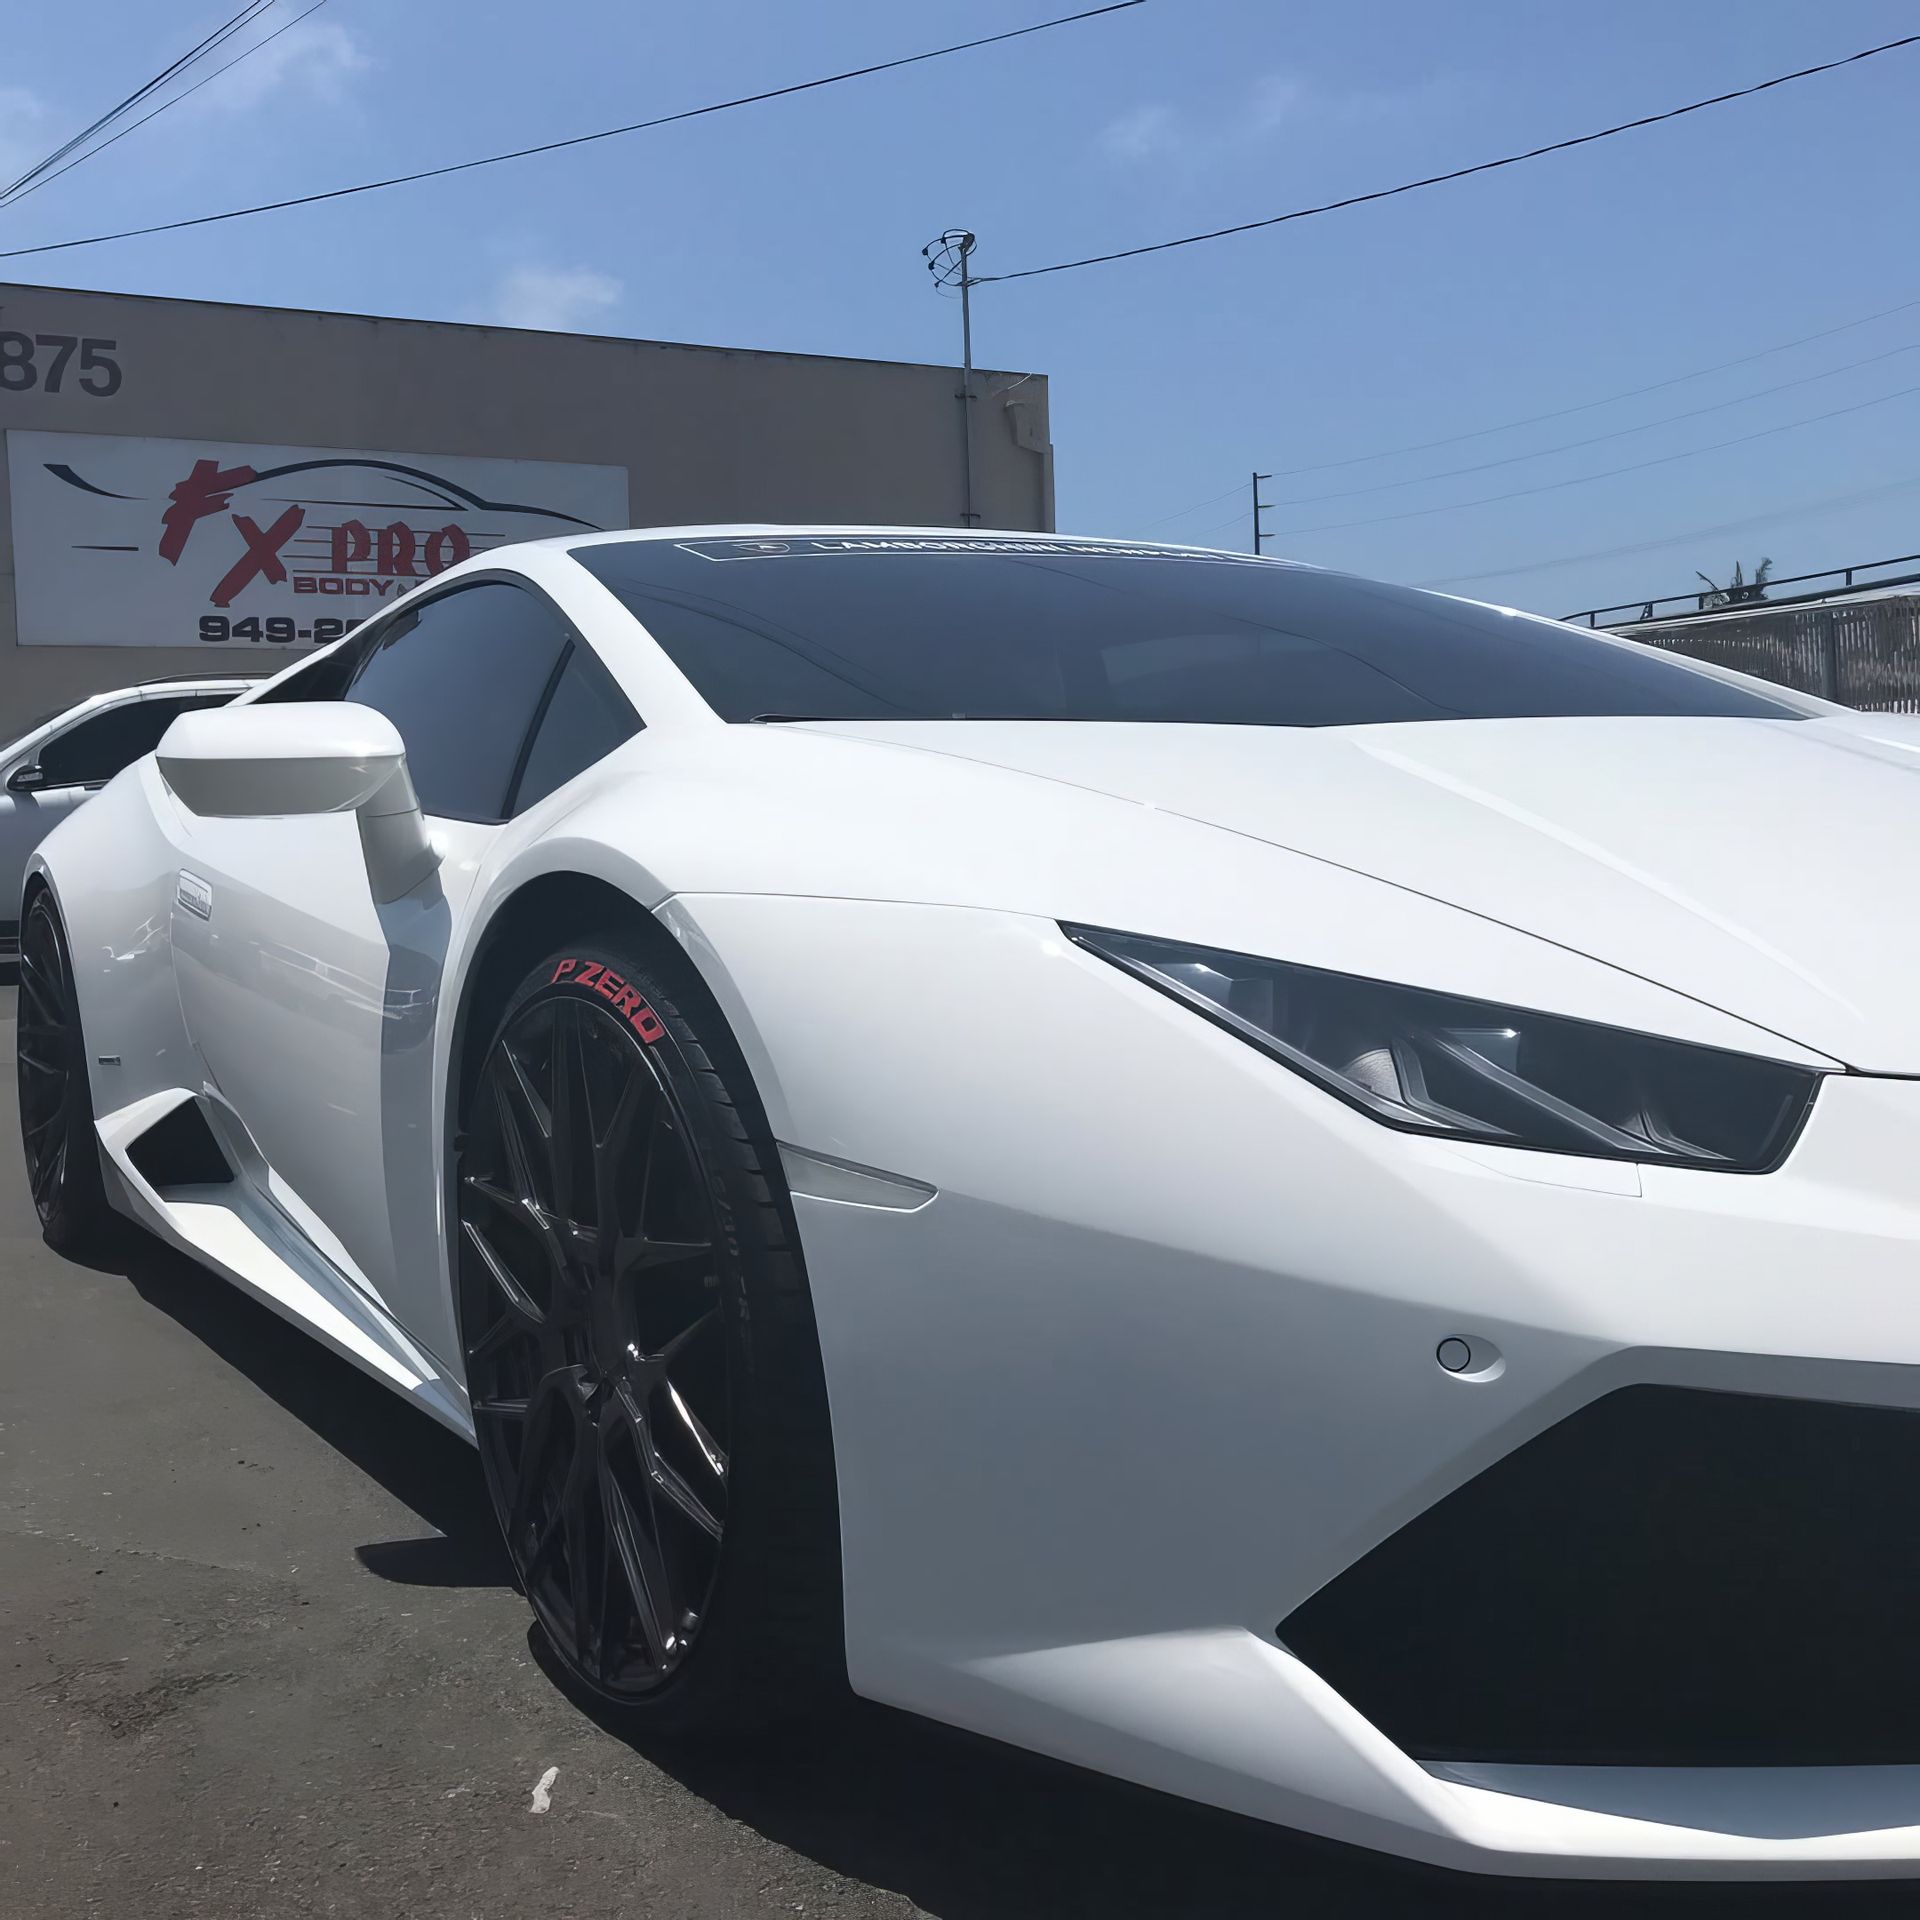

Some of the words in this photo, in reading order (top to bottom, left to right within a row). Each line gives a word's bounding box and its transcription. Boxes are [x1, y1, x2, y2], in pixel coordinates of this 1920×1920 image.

[0, 331, 122, 397] 875
[331, 519, 470, 577] PRO
[293, 576, 394, 597] BODY
[551, 958, 577, 984] P
[573, 960, 667, 1044] ZERO
